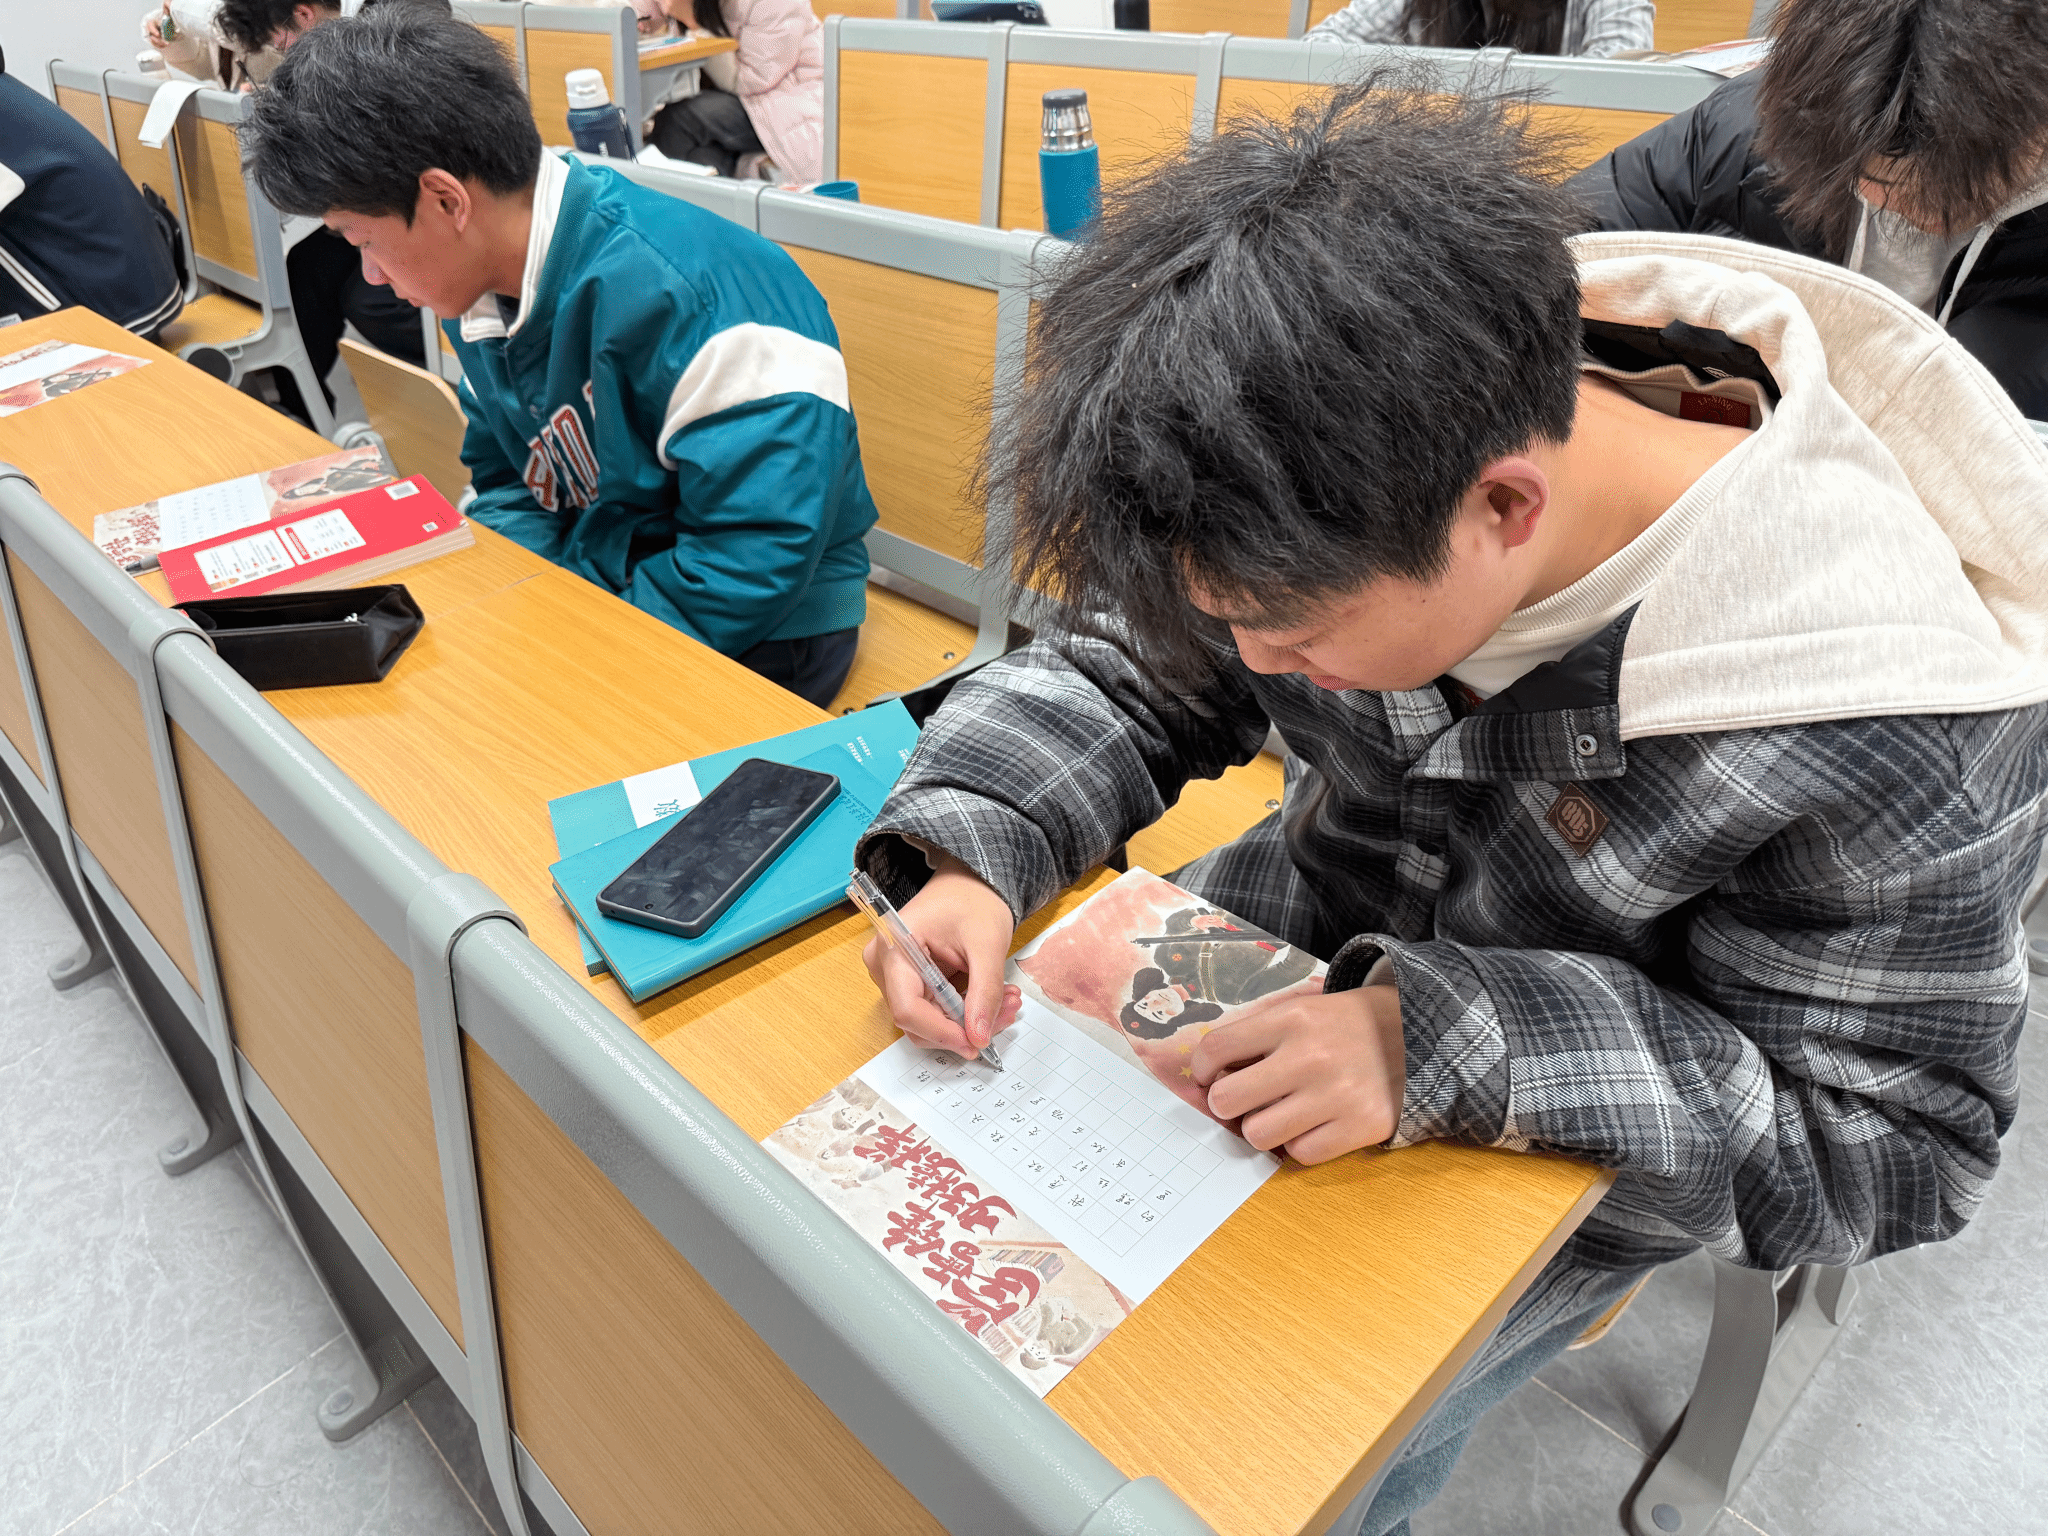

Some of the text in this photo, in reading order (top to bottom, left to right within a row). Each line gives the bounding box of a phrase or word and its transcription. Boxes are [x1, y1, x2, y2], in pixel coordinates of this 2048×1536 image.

[853, 1123, 1018, 1236] 好榜样
[881, 1200, 1041, 1338] 学雷锋
